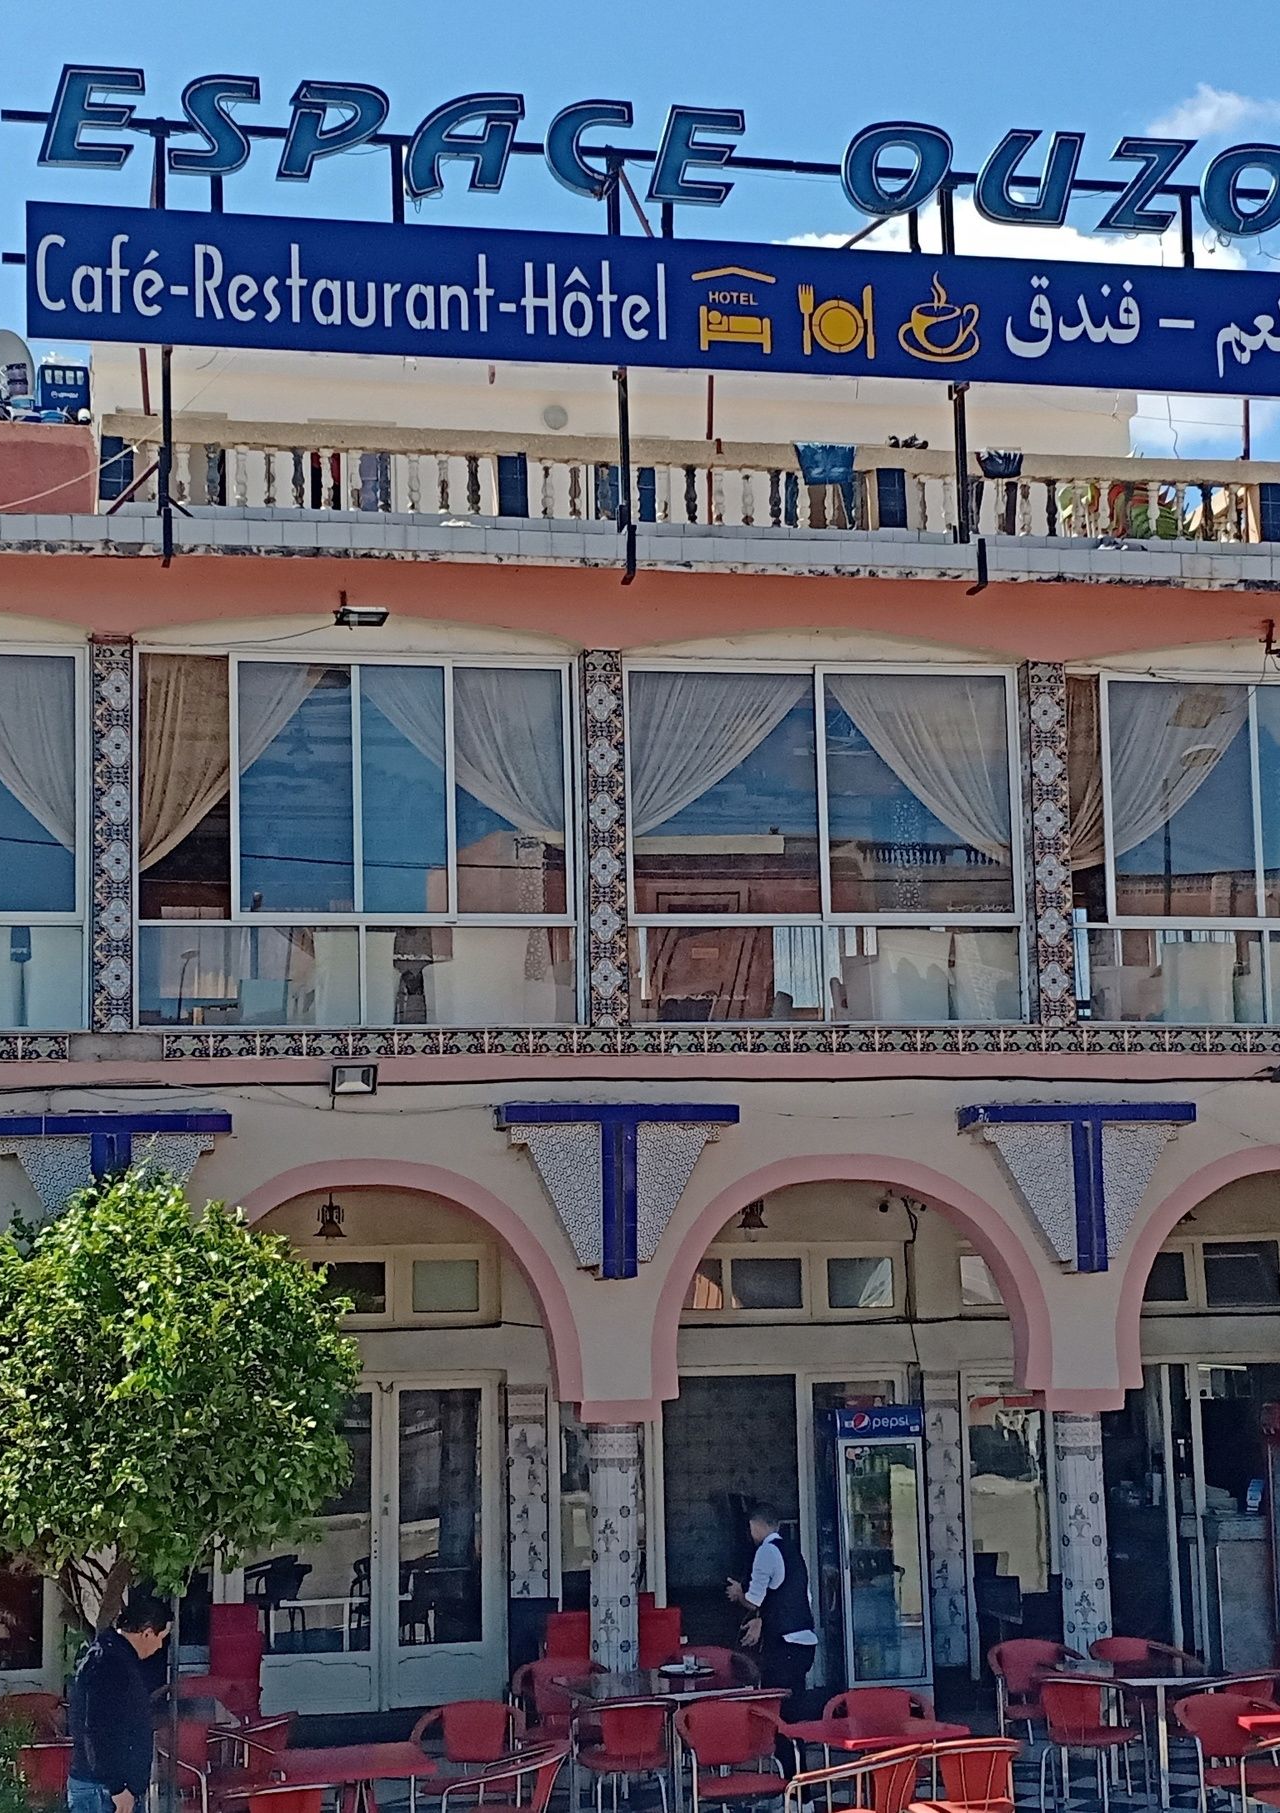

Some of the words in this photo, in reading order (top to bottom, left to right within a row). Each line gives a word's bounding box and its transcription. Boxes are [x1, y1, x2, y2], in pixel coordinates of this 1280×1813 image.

[36, 63, 746, 207] ESPACE
[35, 233, 669, 341] Café-Restaurant-Hôtel
[708, 290, 758, 306] HOTEL
[1005, 275, 1140, 358] فندق
[872, 1414, 910, 1430] pepsi
